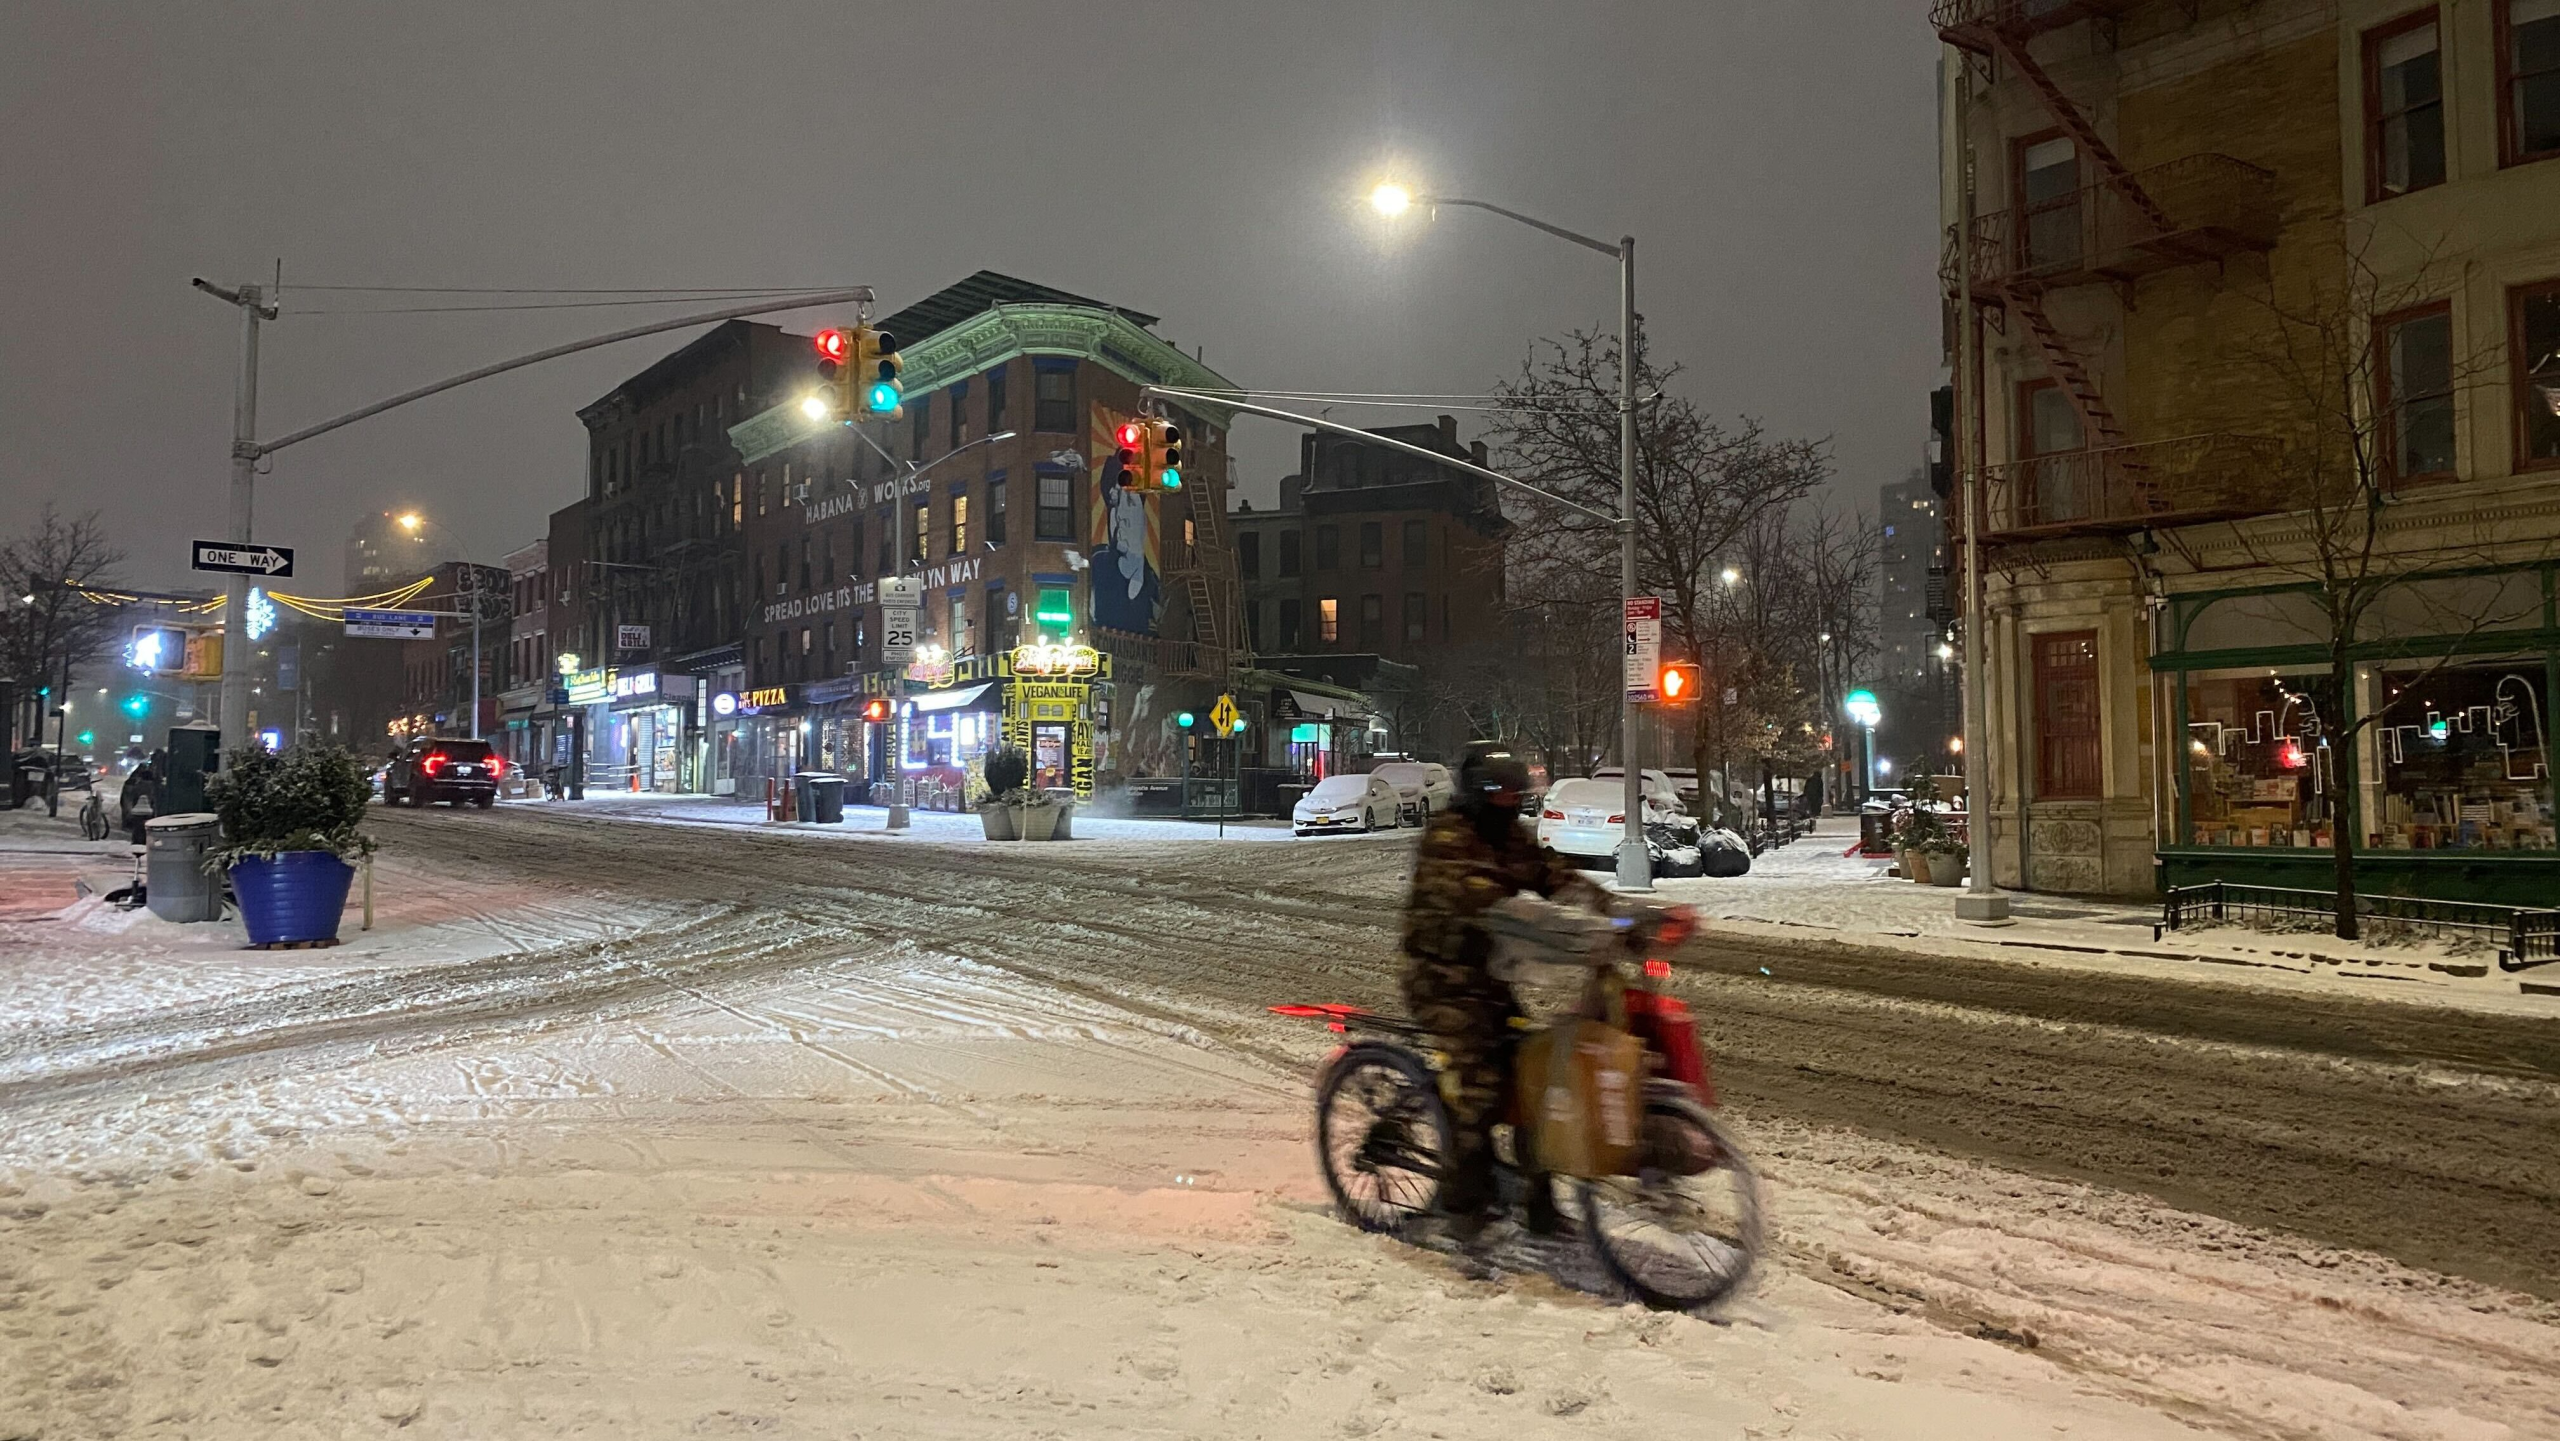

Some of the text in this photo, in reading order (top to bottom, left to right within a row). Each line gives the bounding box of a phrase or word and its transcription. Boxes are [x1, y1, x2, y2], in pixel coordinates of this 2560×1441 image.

[806, 493, 853, 525] HABANA
[207, 551, 279, 567] ONE WAY
[764, 598, 801, 623] SPREAD
[805, 591, 835, 615] LOVE
[853, 582, 874, 604] THE
[950, 557, 981, 585] WAY
[621, 632, 642, 640] DELI
[887, 630, 913, 646] 25
[1628, 645, 1635, 654] 2
[752, 688, 787, 707] PIZZA
[1022, 685, 1059, 698] VEGAN
[1064, 686, 1082, 698] LIFE
[1016, 720, 1029, 748] LANTS
[1076, 758, 1093, 801] EGAN
